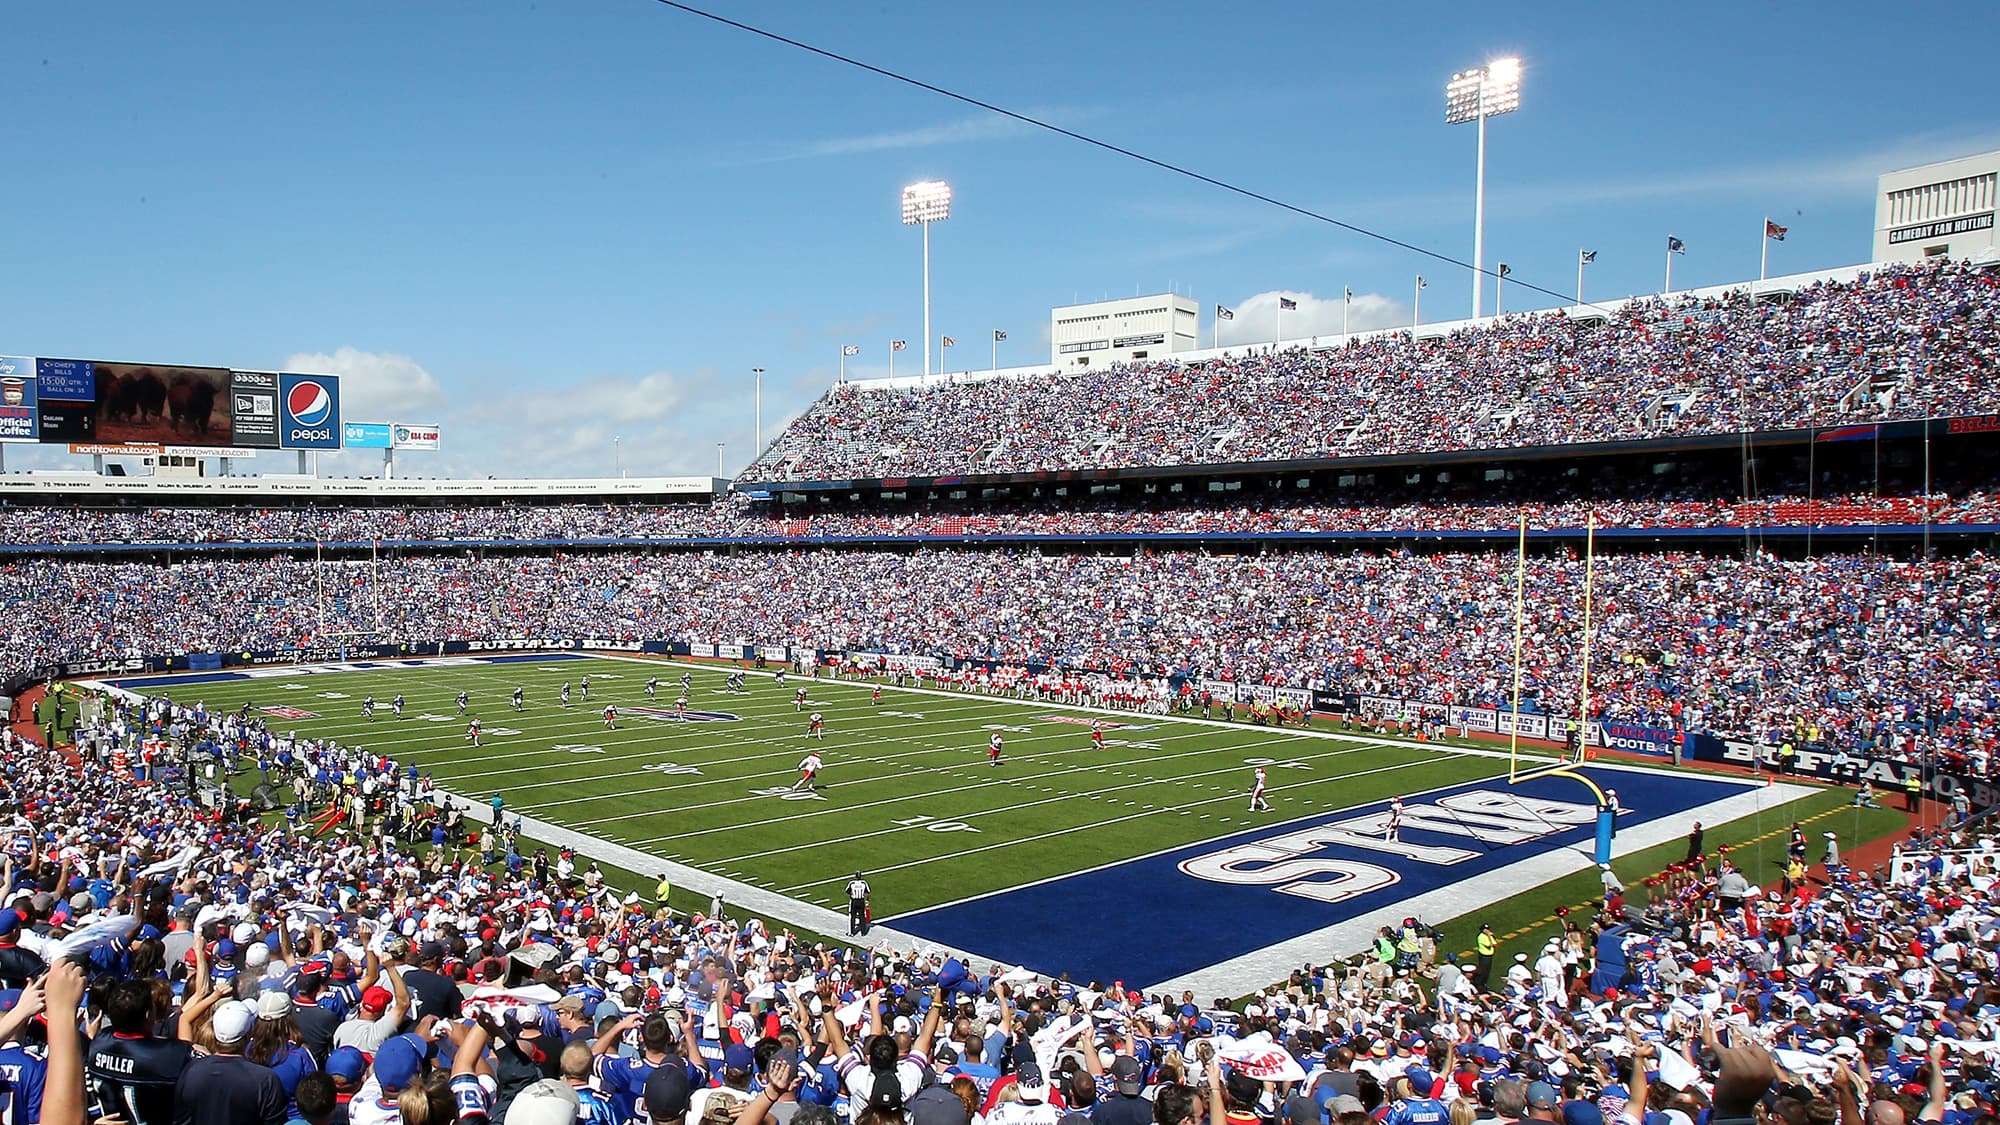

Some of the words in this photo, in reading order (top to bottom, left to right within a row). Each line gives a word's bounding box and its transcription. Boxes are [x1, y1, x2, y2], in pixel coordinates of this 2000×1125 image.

[1890, 226, 1933, 243] GAMEDAY
[1934, 222, 1952, 236] FAN
[1954, 214, 1993, 232] HOTLINE
[41, 376, 66, 386] 15:00
[0, 417, 33, 427] Official
[0, 426, 31, 436] Coffee
[291, 428, 331, 442] pepsi
[76, 445, 160, 455] northtownauto.com
[172, 447, 250, 457] northtownauto.com
[468, 639, 576, 650] BUFFALO
[582, 639, 643, 650] BILLS
[66, 659, 144, 675] BILLS
[1611, 726, 1647, 739] BACK
[1651, 730, 1669, 740] TO
[891, 815, 970, 833] 10
[95, 1052, 135, 1074] SPILLER
